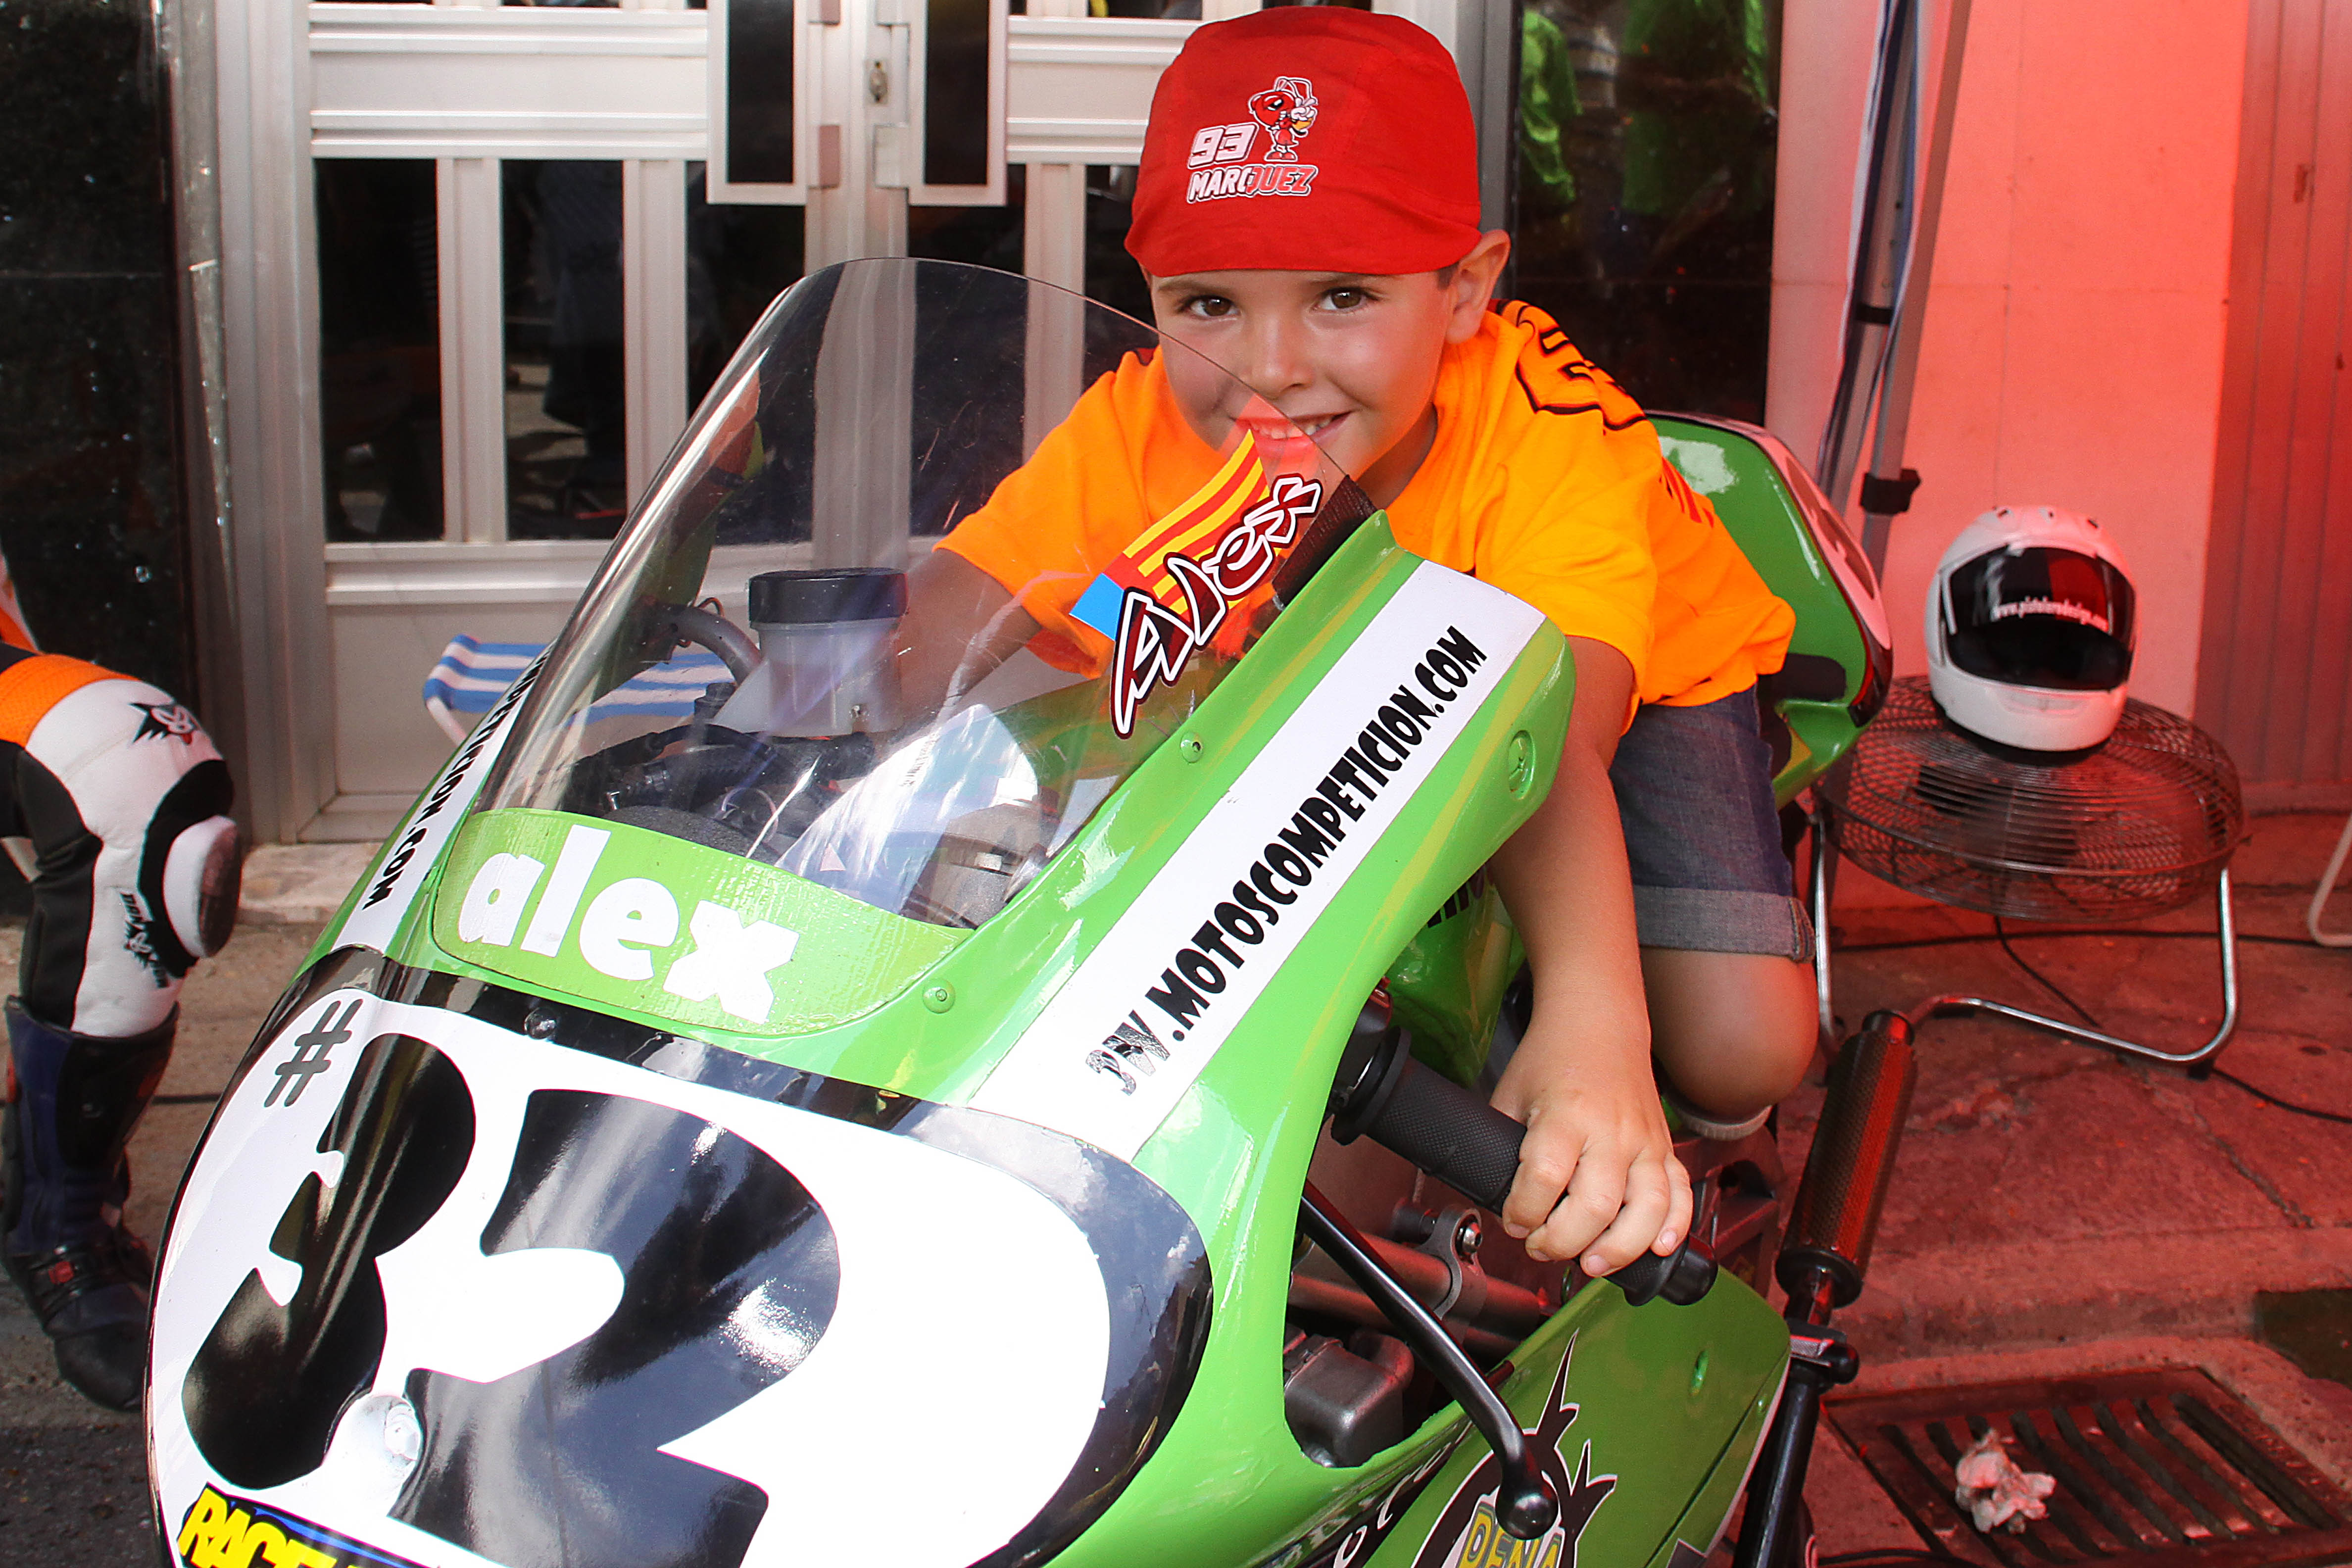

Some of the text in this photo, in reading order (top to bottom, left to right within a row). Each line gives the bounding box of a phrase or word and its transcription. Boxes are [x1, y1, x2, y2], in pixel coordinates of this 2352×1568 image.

[1187, 123, 1259, 169] 93
[1187, 164, 1319, 203] MARQUEZ
[1110, 473, 1323, 739] Alex
[457, 824, 800, 1025] alex
